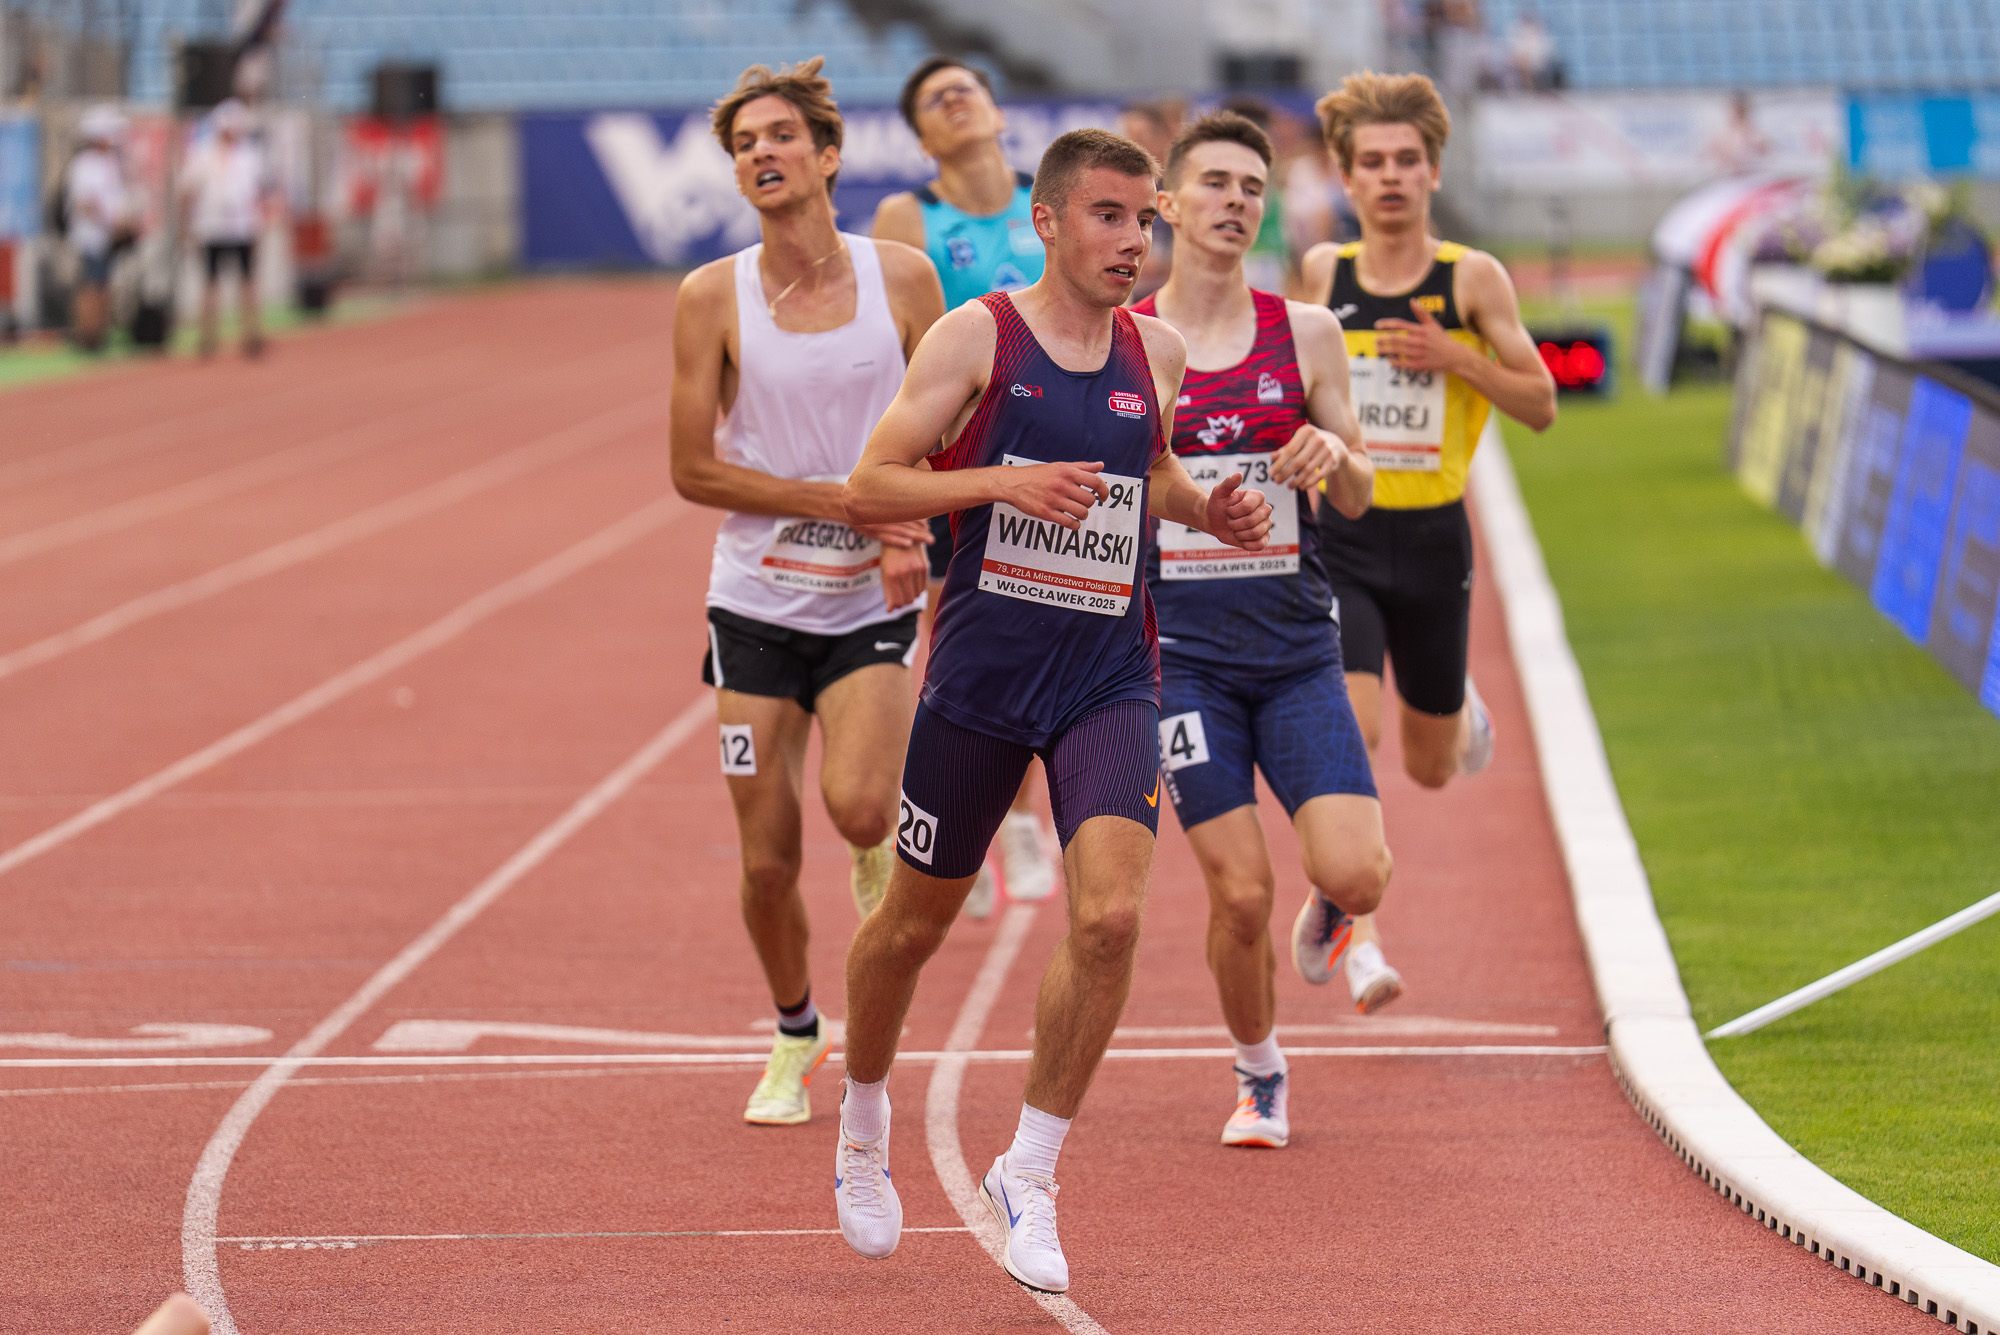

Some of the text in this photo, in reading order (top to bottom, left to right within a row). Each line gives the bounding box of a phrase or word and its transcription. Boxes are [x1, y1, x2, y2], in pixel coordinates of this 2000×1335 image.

[1113, 399, 1142, 411] TALEX
[1237, 461, 1275, 485] 73
[999, 513, 1133, 566] WINIARSKI
[997, 564, 1121, 593] 79. PZLA Mistrzostwa Polski U20
[1259, 559, 1287, 571] 2025
[996, 579, 1116, 610] WŁOCŁAWEK 2025
[720, 735, 752, 766] 12
[898, 803, 933, 854] 20
